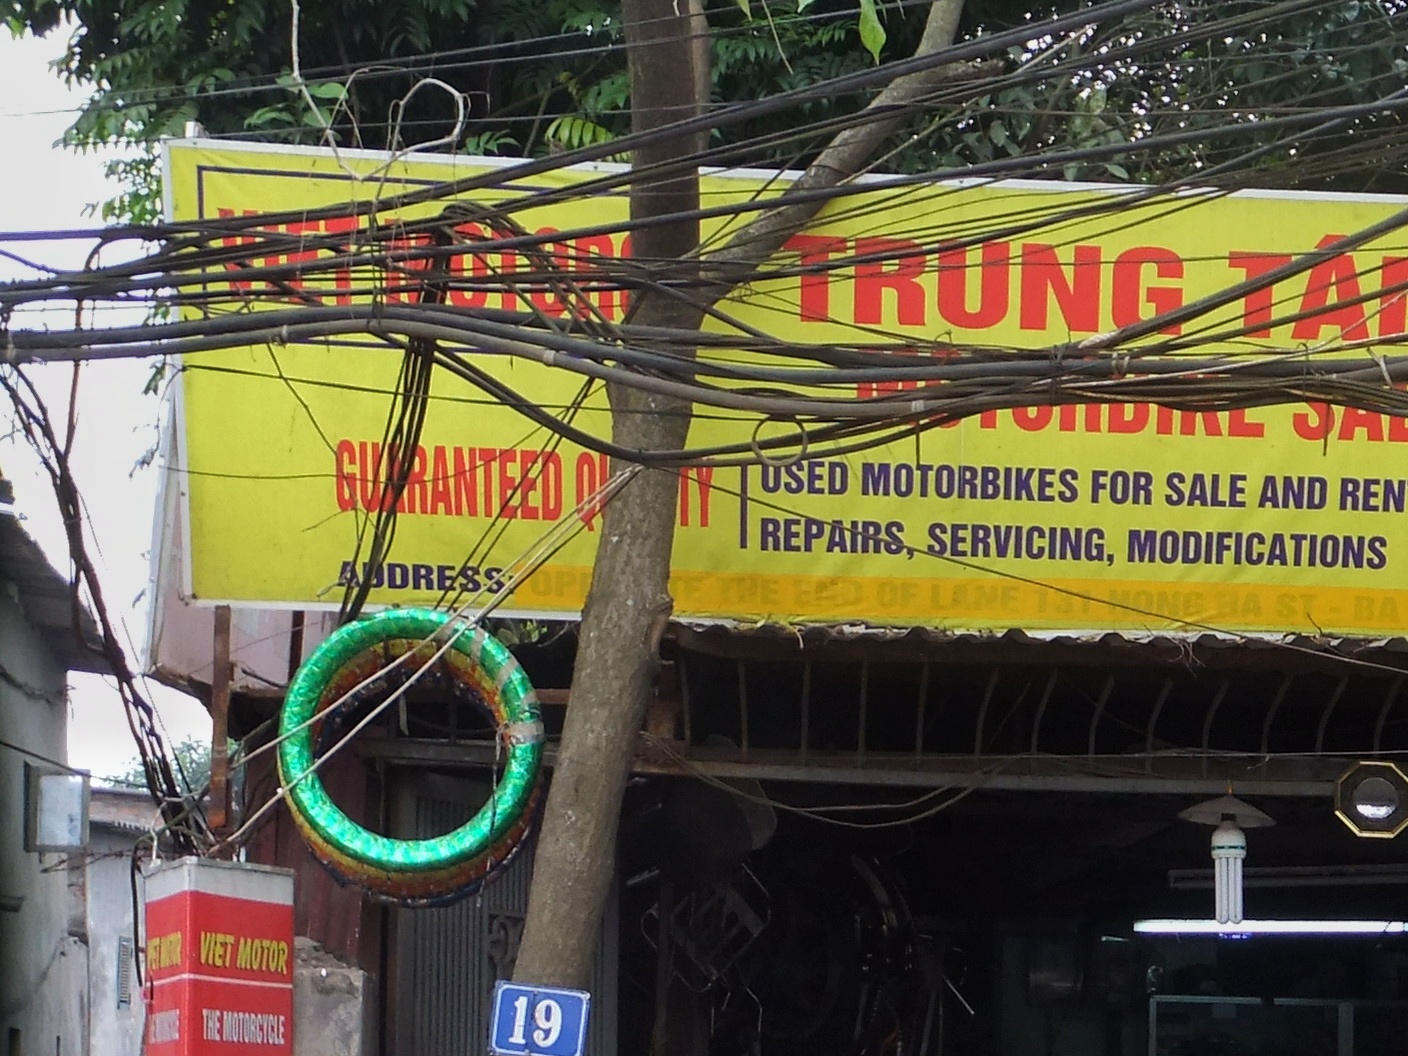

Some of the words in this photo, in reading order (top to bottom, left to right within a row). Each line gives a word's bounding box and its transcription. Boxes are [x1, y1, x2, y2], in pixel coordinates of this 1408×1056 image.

[782, 233, 1185, 336] TRUNG
[335, 438, 564, 522] GUARANTEED
[761, 460, 849, 496] USED
[861, 462, 1079, 504] MOTORBIKES
[1091, 470, 1154, 508] FOR
[1166, 472, 1247, 510] SALE
[1257, 475, 1328, 512] AND
[760, 517, 915, 560] REPAIRS,
[927, 522, 1115, 567] SERVICING,
[1126, 528, 1388, 571] MODIFICATIONS
[200, 930, 236, 968] VIET
[237, 938, 288, 975] MOTOR
[202, 1008, 222, 1041] THE
[223, 1010, 286, 1046] MOTORCYCLE
[508, 995, 563, 1048] 19
